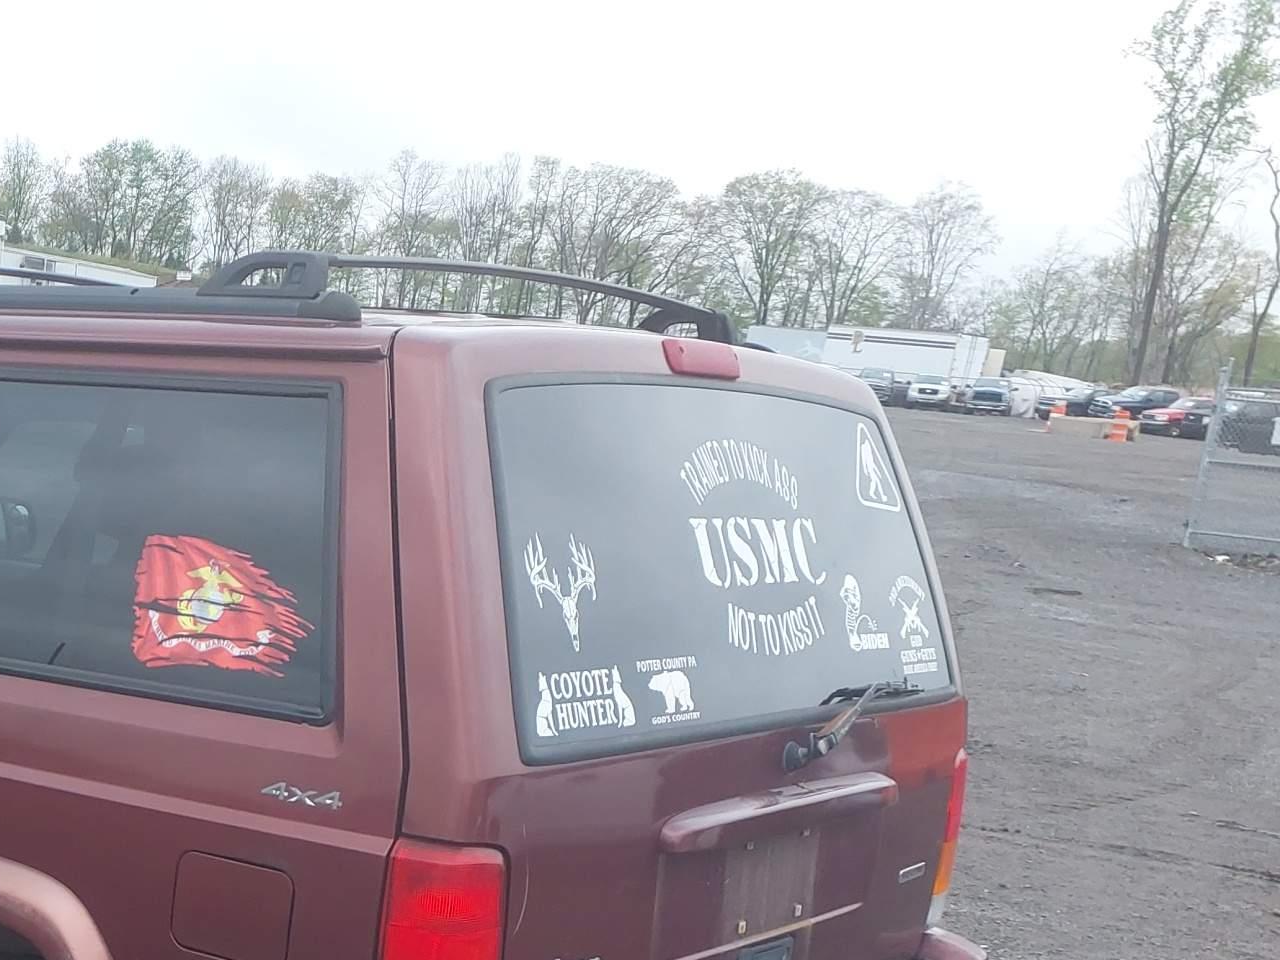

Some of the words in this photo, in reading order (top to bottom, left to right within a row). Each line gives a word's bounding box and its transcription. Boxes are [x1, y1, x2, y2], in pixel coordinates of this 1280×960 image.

[680, 440, 729, 505] TRAINED
[723, 439, 744, 479] TO
[740, 441, 773, 488] KICK
[688, 516, 827, 588] USMC
[728, 603, 757, 654] NOT
[759, 614, 780, 656] TO
[777, 606, 813, 656] KISS
[805, 596, 825, 639] IT
[860, 632, 890, 650] BIDEN
[636, 660, 662, 673] POTTER
[662, 656, 687, 670] COUNTY
[687, 655, 697, 667] PA
[550, 668, 613, 700] COYOTE
[555, 698, 618, 731] HUNTER
[651, 714, 671, 725] GOD'S
[671, 711, 701, 723] COUNTRY
